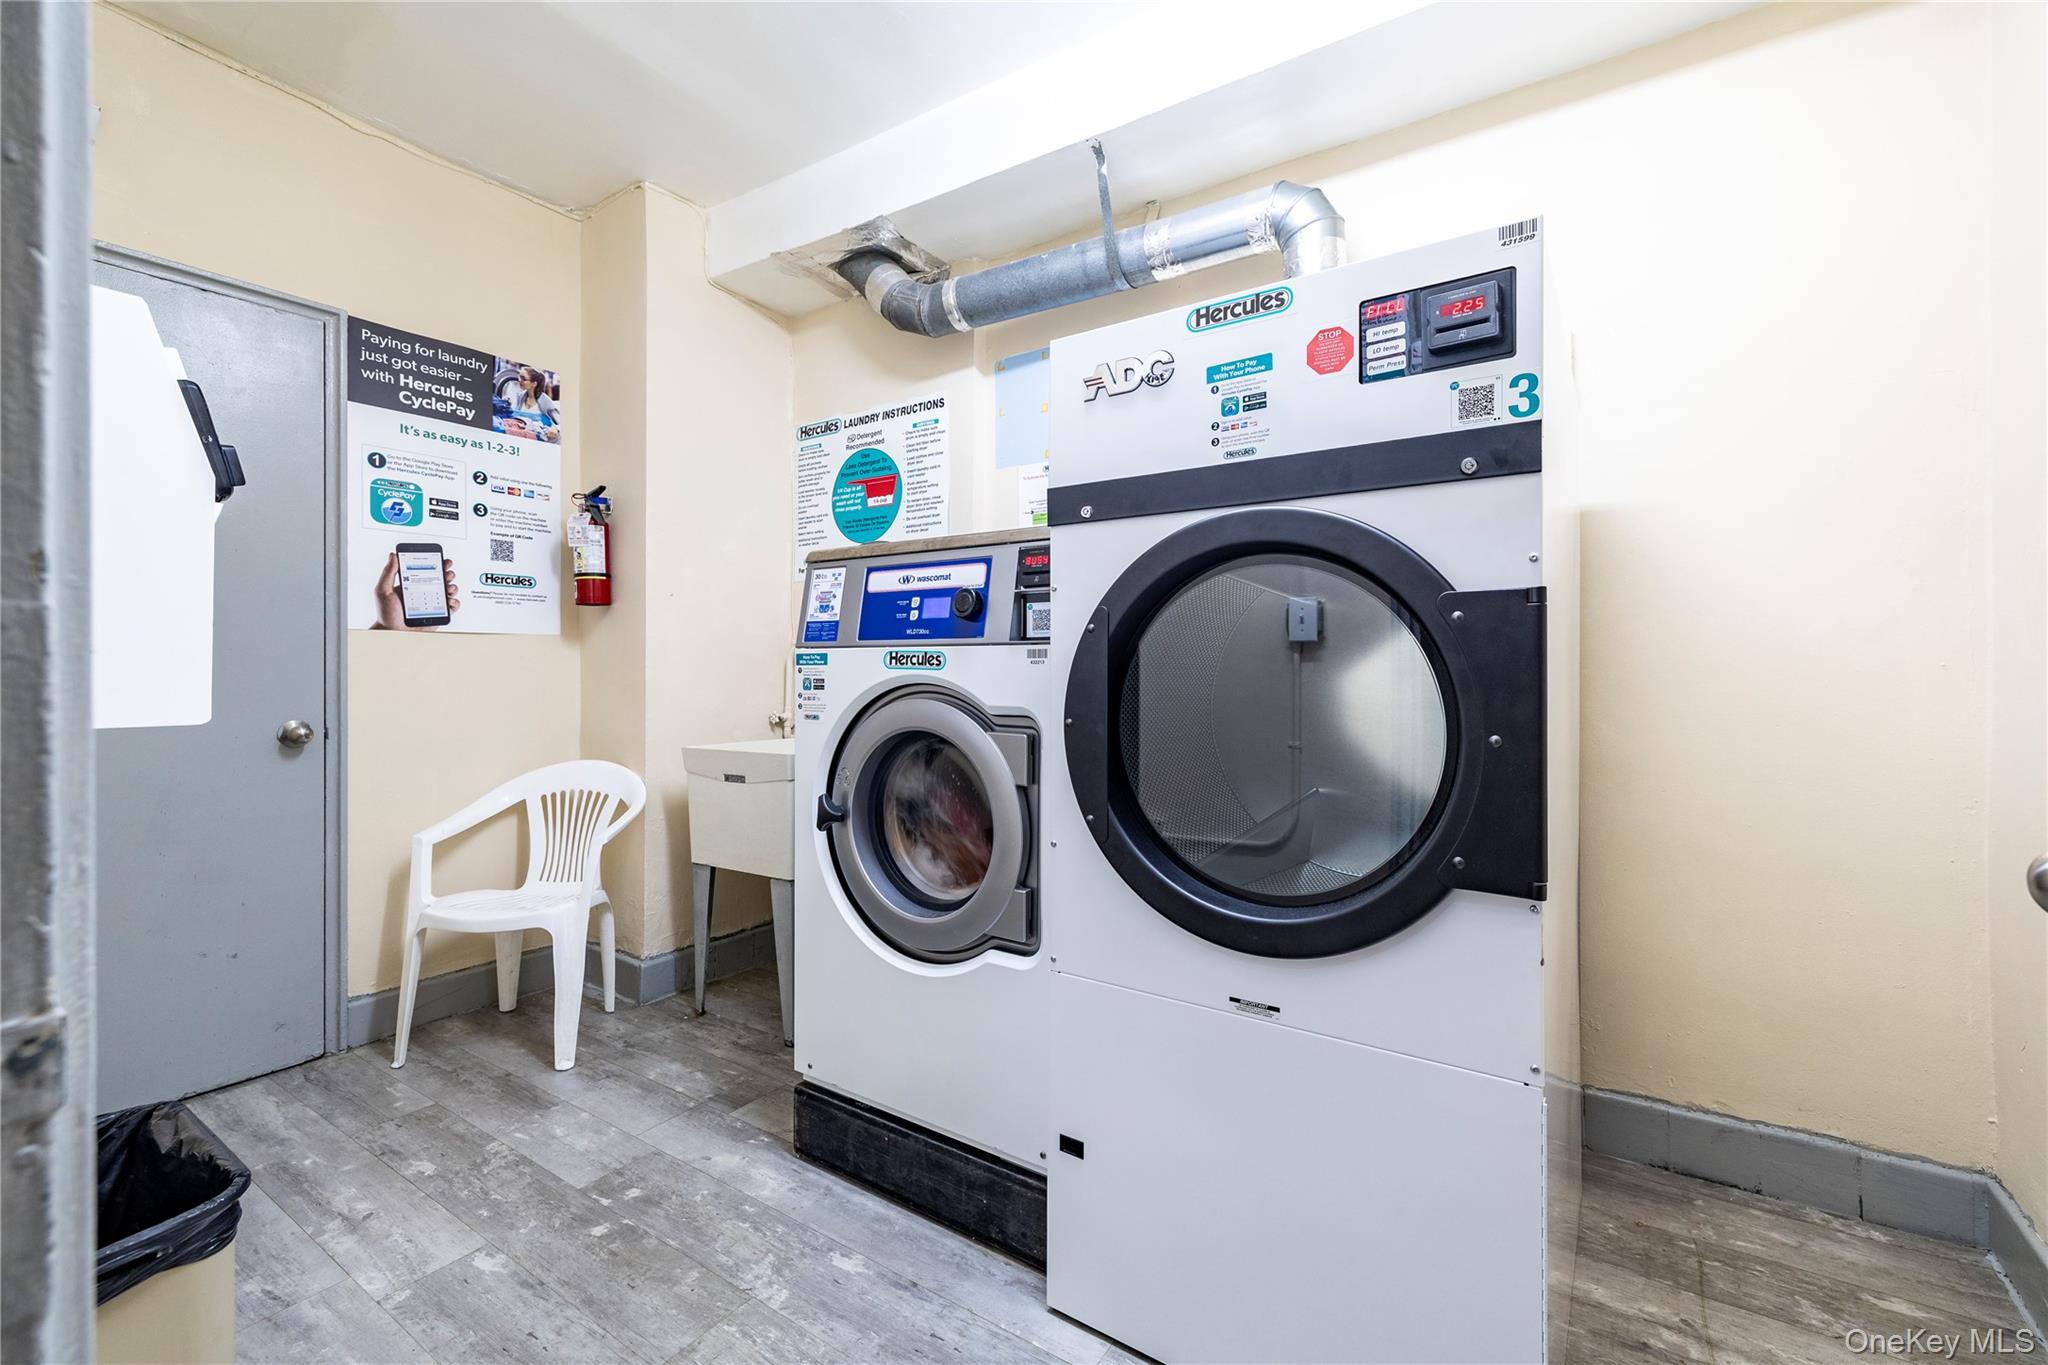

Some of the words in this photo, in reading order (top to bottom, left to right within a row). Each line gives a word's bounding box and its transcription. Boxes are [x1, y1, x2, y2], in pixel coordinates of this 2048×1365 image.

[1501, 233, 1535, 247] 431599
[1196, 292, 1286, 328] Hercules
[1452, 296, 1484, 315] 2.25
[1318, 330, 1342, 341] STOP
[1382, 326, 1398, 336] temp
[361, 328, 411, 354] Paying
[415, 343, 435, 358] for
[438, 348, 488, 373] laundry
[1382, 344, 1400, 352] temp
[360, 347, 388, 363] just
[391, 355, 417, 372] got
[420, 364, 461, 382] easier
[1245, 365, 1265, 373] Phone
[1368, 362, 1385, 372] Perm
[1386, 359, 1404, 368] Press
[361, 368, 394, 384] with
[400, 374, 473, 402] Hercules
[1508, 372, 1540, 418] 3
[399, 390, 476, 421] CyclePay
[800, 421, 839, 439] Hercules
[843, 413, 880, 430] LAUNDRY
[882, 398, 945, 421] INSTRUCTIONS
[400, 423, 420, 438] It's
[423, 430, 437, 440] as
[440, 432, 468, 449] easy
[470, 440, 484, 450] as
[487, 441, 520, 456] 1-2-3!
[857, 430, 882, 440] Detergent
[846, 438, 884, 450] Recommended
[1226, 448, 1254, 458] Hercules
[372, 454, 380, 466] 1
[476, 473, 484, 483] 2
[378, 488, 416, 501] CyclePay
[476, 504, 485, 516] 3
[485, 573, 532, 587] Hercules
[916, 573, 951, 582] wascomat
[889, 651, 942, 666] Hercules
